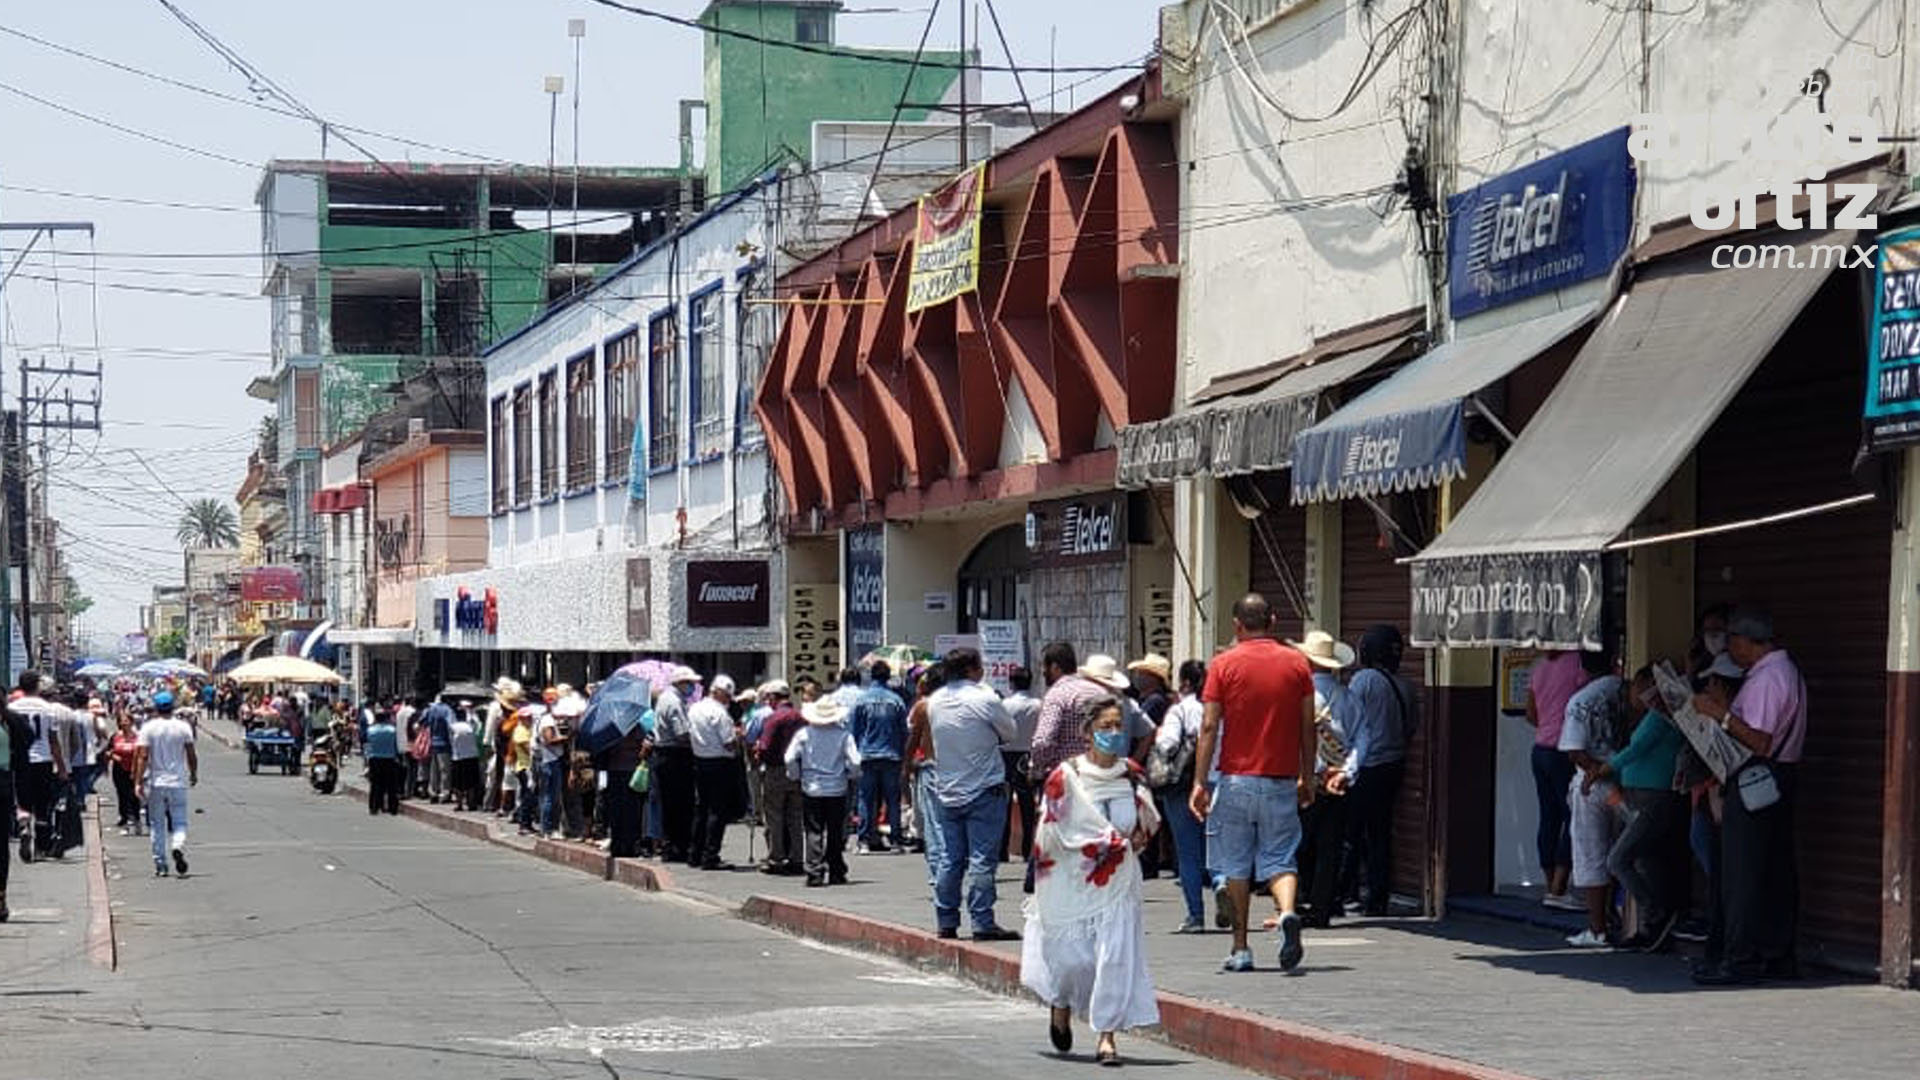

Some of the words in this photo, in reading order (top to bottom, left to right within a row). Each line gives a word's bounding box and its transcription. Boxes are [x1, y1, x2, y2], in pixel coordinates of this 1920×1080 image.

[1490, 170, 1567, 263] telcel
[1358, 428, 1402, 473] telcel
[1073, 500, 1117, 553] telcel
